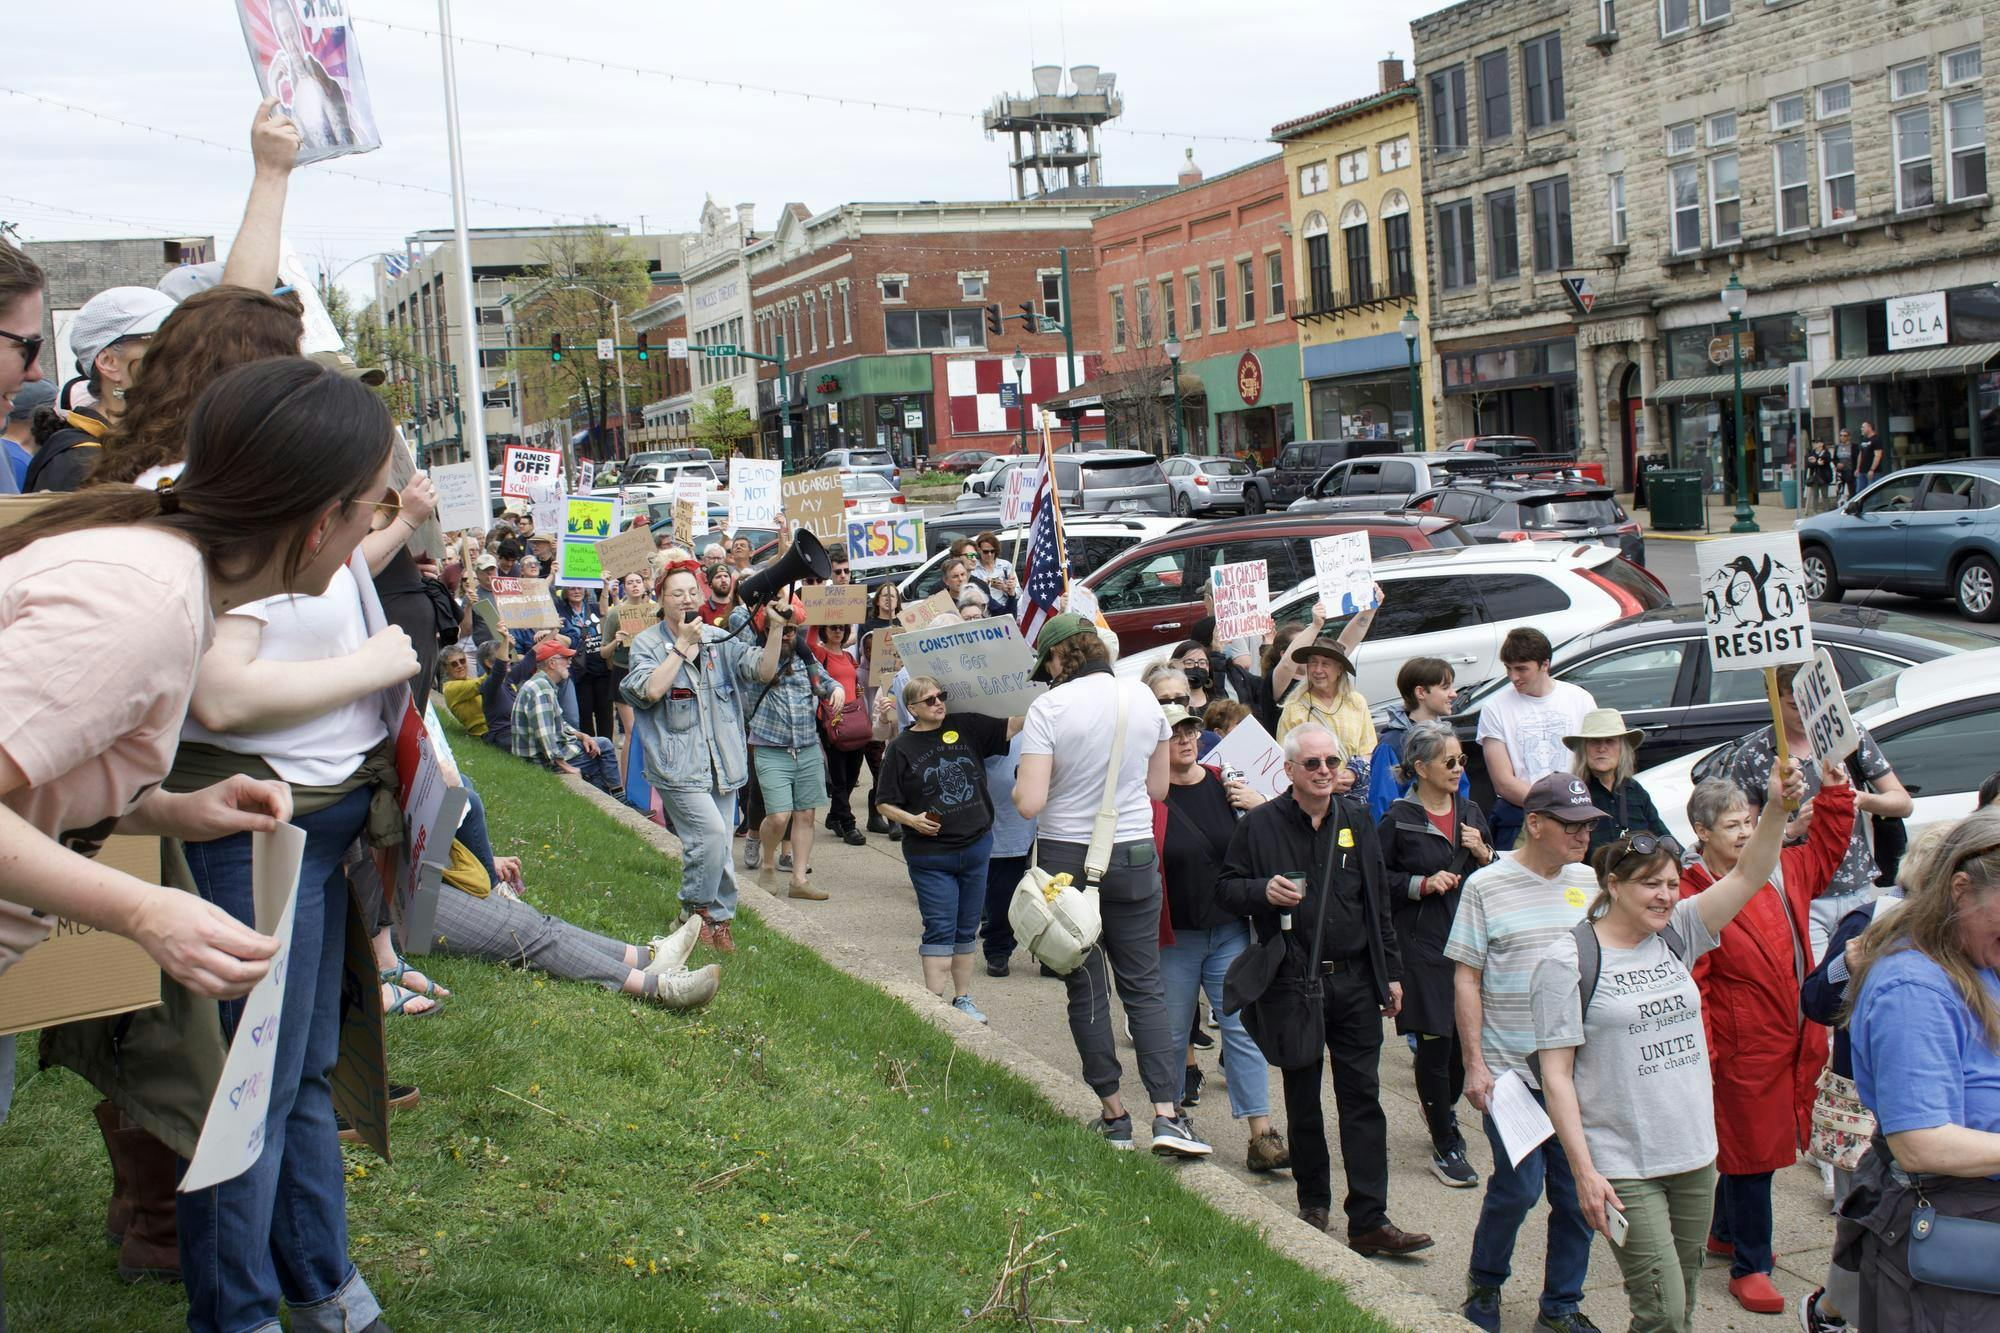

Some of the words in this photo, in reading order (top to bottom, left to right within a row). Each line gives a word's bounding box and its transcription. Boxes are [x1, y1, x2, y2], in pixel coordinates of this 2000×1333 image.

[1890, 315, 1944, 336] LOLA
[513, 460, 550, 476] OFF!
[514, 451, 551, 463] HANDS
[744, 486, 768, 502] NOT
[1008, 471, 1023, 496] NO
[800, 498, 822, 513] MY
[1004, 496, 1020, 521] NO
[847, 518, 923, 560] RESIST
[1236, 561, 1266, 584] CARING
[619, 608, 638, 620] HATE
[919, 624, 1012, 654] CONSTITUTION!
[1217, 616, 1238, 639] YOU
[1715, 624, 1804, 659] RESIST
[960, 653, 988, 672] GOT
[941, 680, 977, 702] OUR
[1797, 660, 1831, 721] SAVE
[1809, 703, 1845, 761] USPS
[1613, 961, 1678, 988] RESIST
[1610, 982, 1644, 997] with
[1637, 994, 1687, 1020] ROAR
[1628, 1023, 1649, 1035] for
[1655, 1009, 1698, 1032] justice
[1640, 1033, 1696, 1062] UNITE
[1638, 1064, 1660, 1076] for
[1663, 1051, 1701, 1070] change
